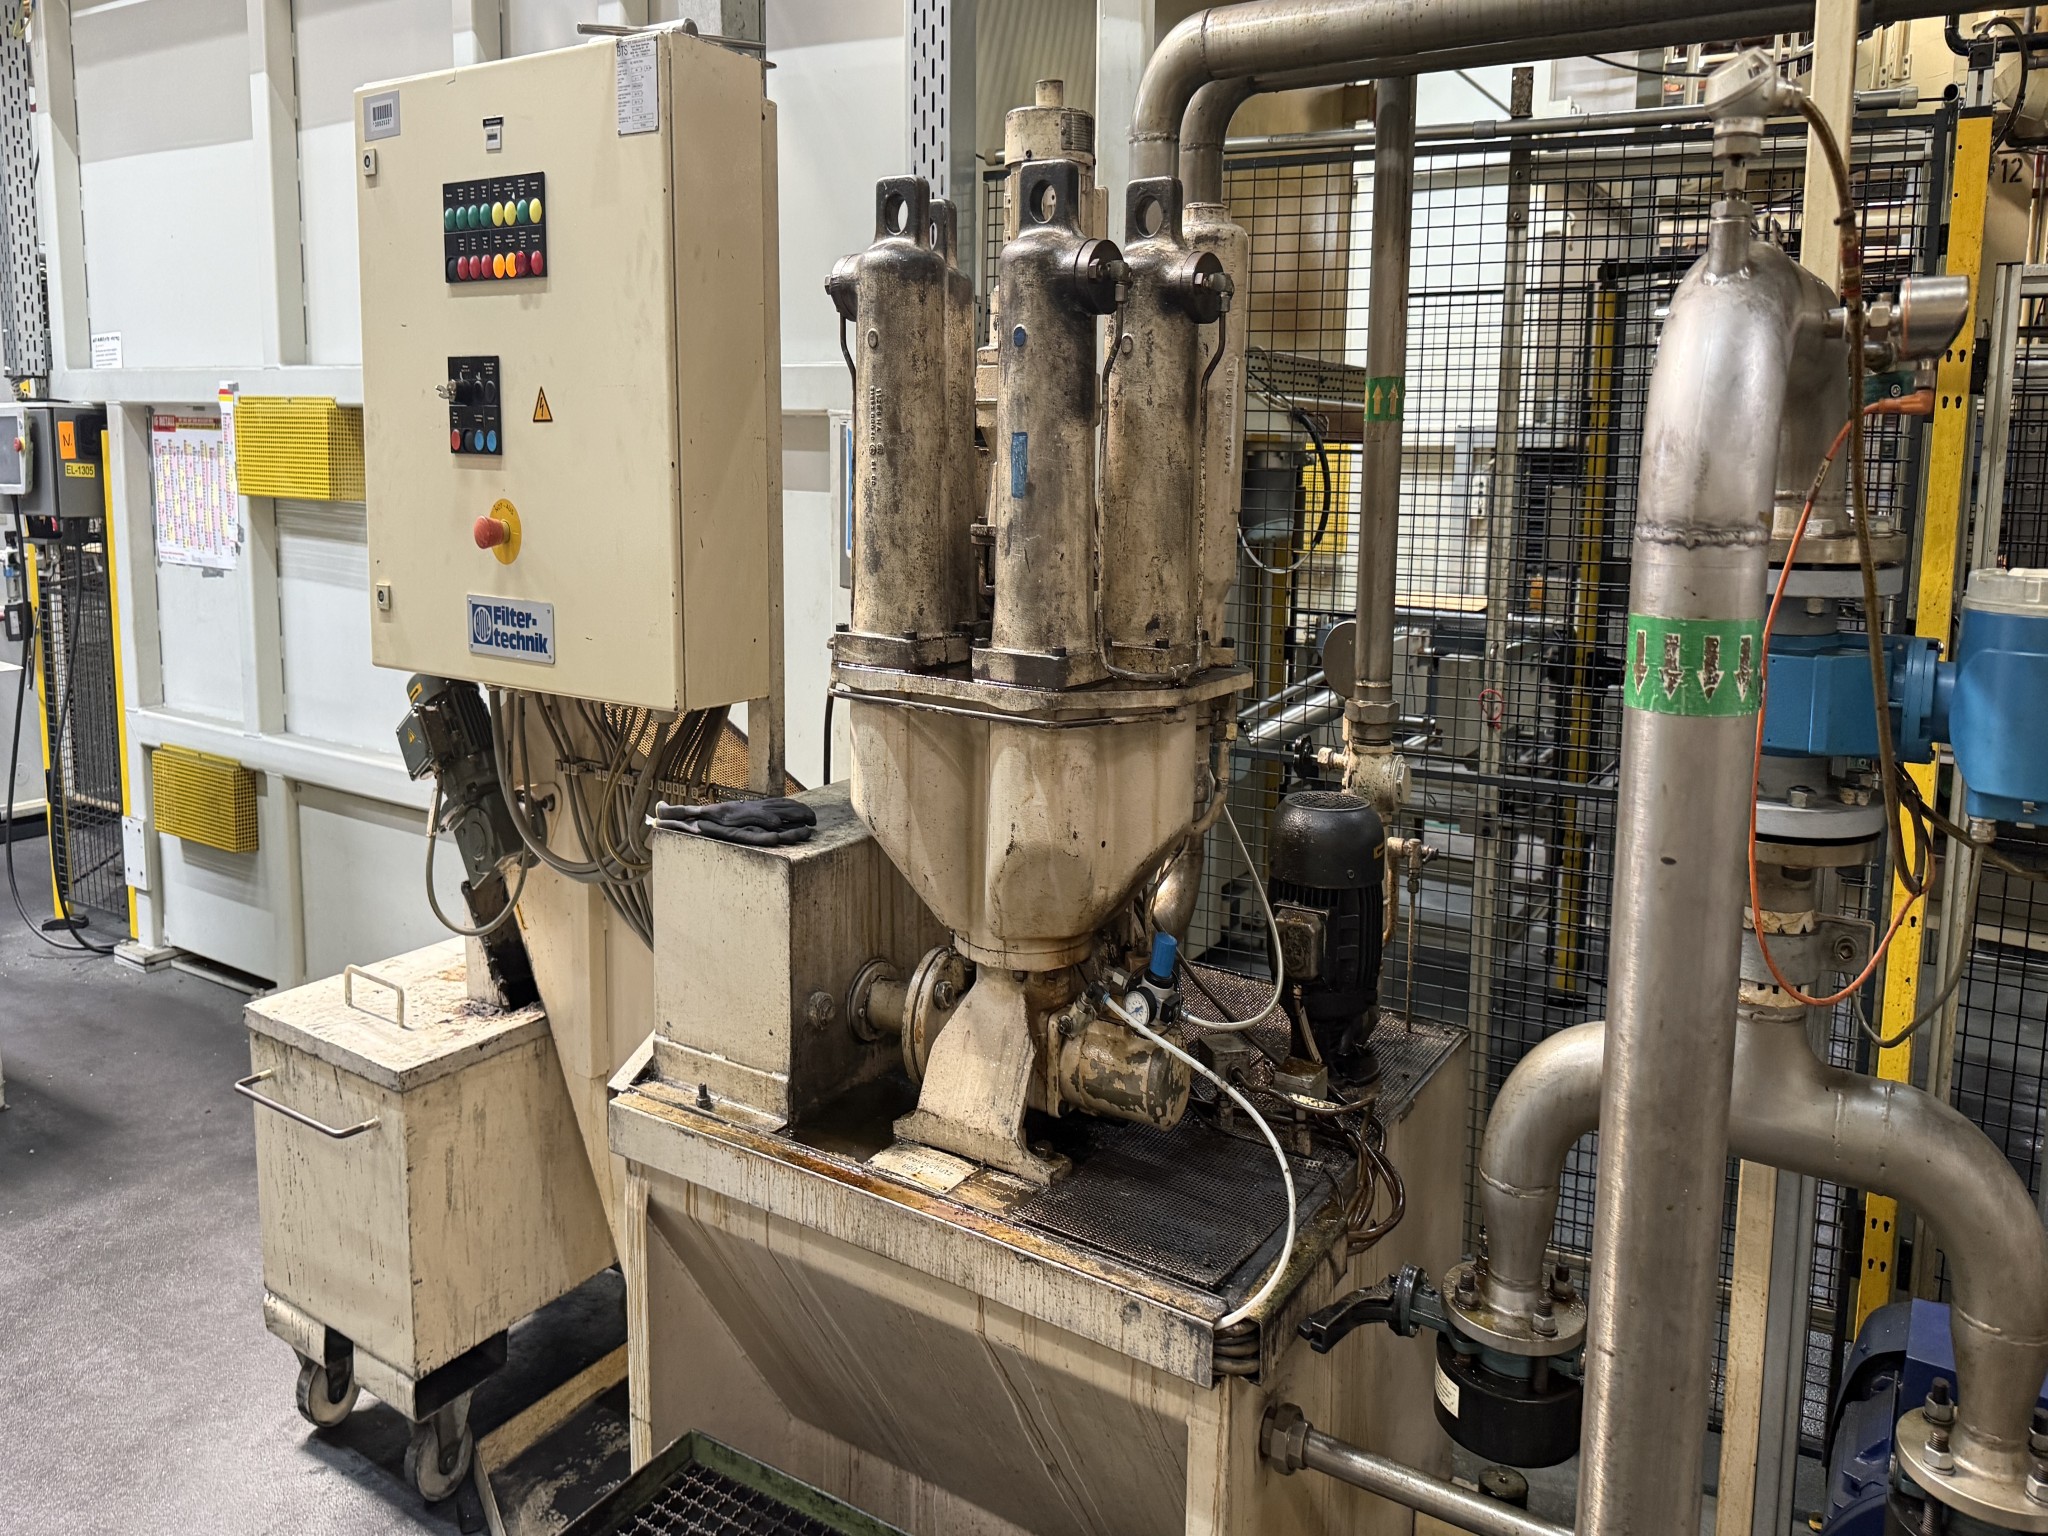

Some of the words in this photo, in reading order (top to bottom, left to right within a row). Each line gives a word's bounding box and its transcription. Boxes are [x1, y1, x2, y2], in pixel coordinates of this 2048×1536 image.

[2001, 157, 2023, 183] 12
[66, 464, 94, 476] EL-1305
[493, 605, 538, 629] Filter-
[493, 627, 549, 654] technik
